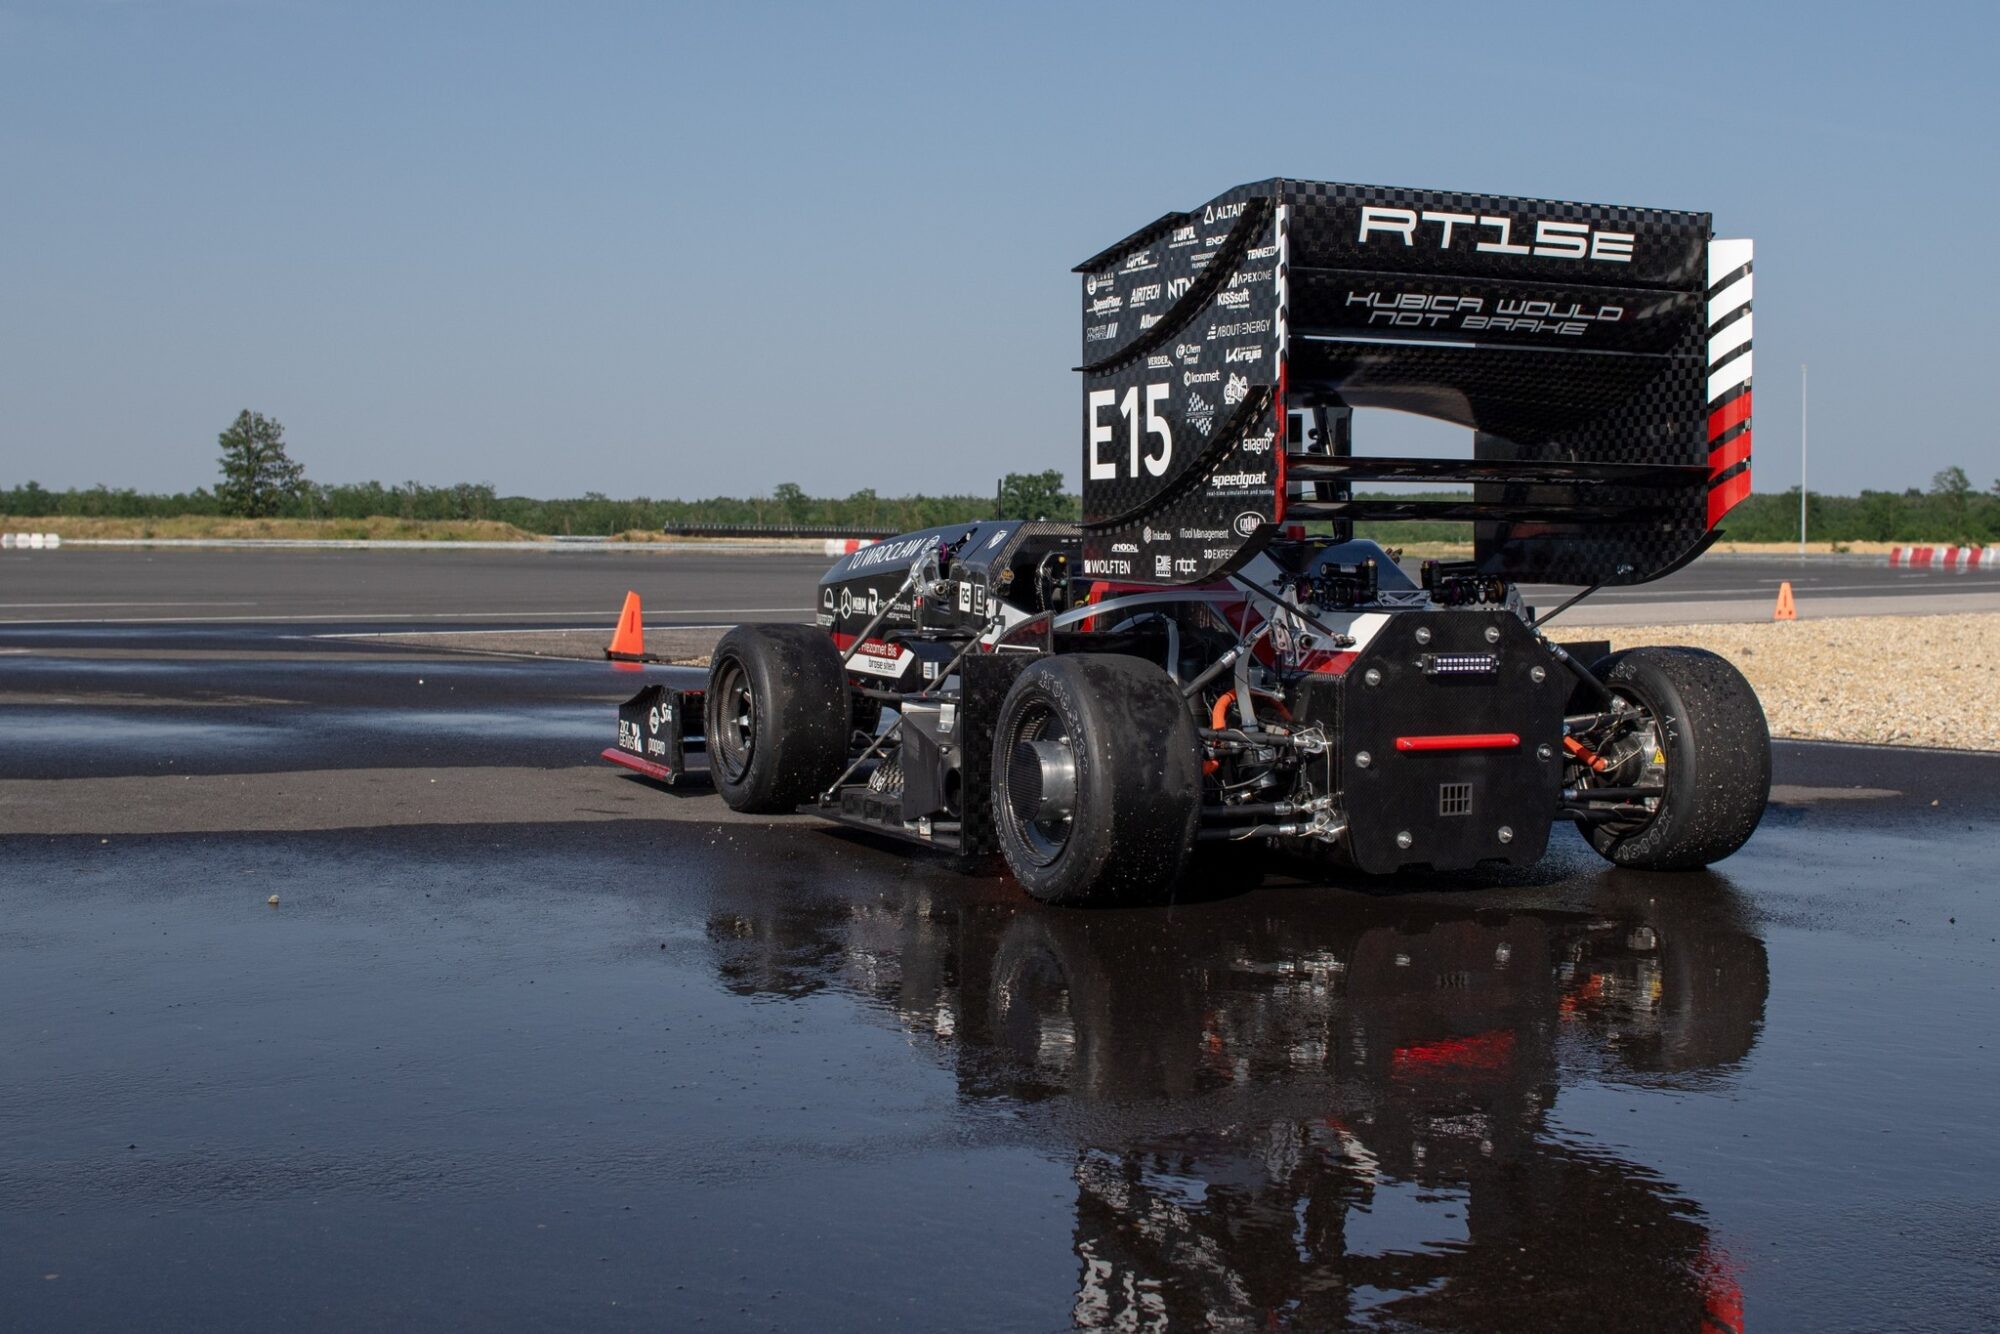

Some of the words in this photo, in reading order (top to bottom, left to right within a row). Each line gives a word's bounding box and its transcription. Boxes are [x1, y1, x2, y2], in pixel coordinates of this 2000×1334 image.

[1247, 245, 1276, 260] TENNECO
[1130, 284, 1161, 304] AIRTECH
[1217, 287, 1250, 306] KISSsoft
[1345, 291, 1484, 313] KUBICA
[1495, 299, 1624, 322] WOULD
[1367, 310, 1450, 328] NOT
[1460, 315, 1589, 336] BRAKE
[1185, 344, 1201, 354] Chem
[1147, 355, 1169, 367] VERDER
[1183, 354, 1199, 365] Trend
[1191, 369, 1220, 383] konmet
[1089, 382, 1173, 480] E15
[1212, 471, 1267, 489] speedgoat
[1193, 528, 1229, 542] Management
[847, 549, 867, 571] TU
[1091, 559, 1131, 575] WOLFTEN
[887, 643, 898, 657] Bis
